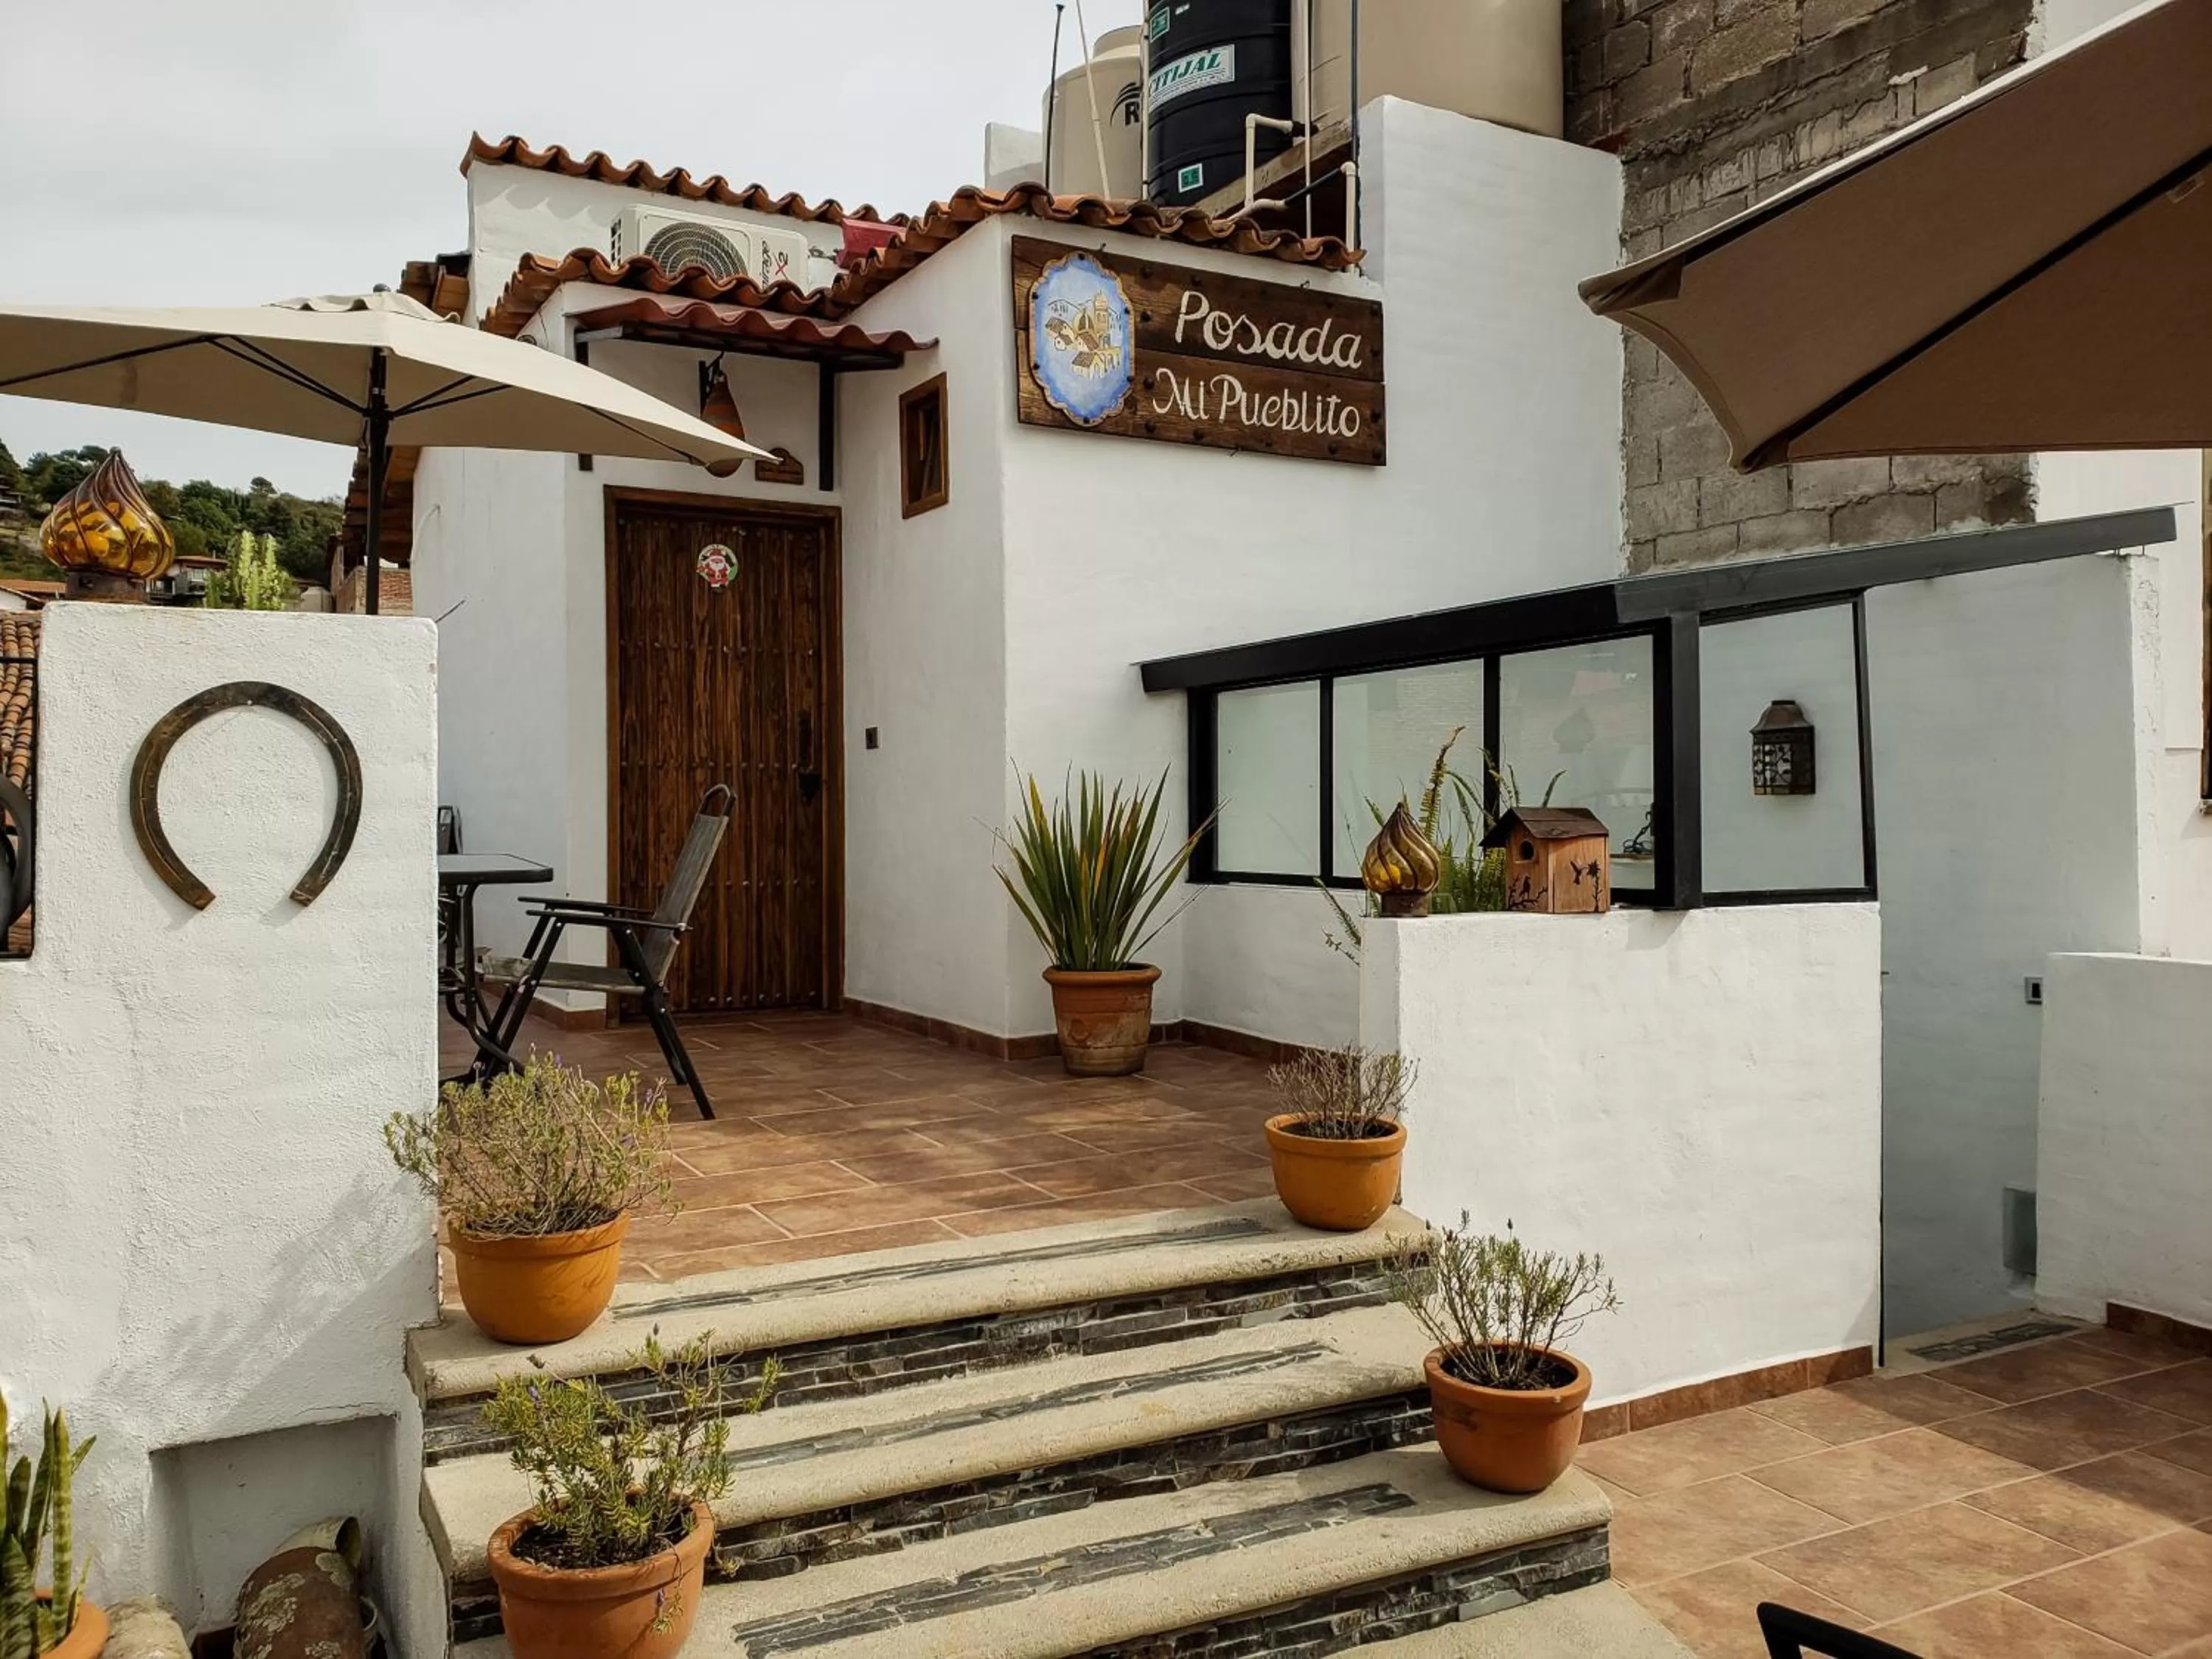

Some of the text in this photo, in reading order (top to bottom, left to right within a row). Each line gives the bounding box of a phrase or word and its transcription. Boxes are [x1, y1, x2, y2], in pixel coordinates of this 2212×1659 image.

[1175, 290, 1362, 369] Posada
[1152, 367, 1360, 437] Mi Pueblito
